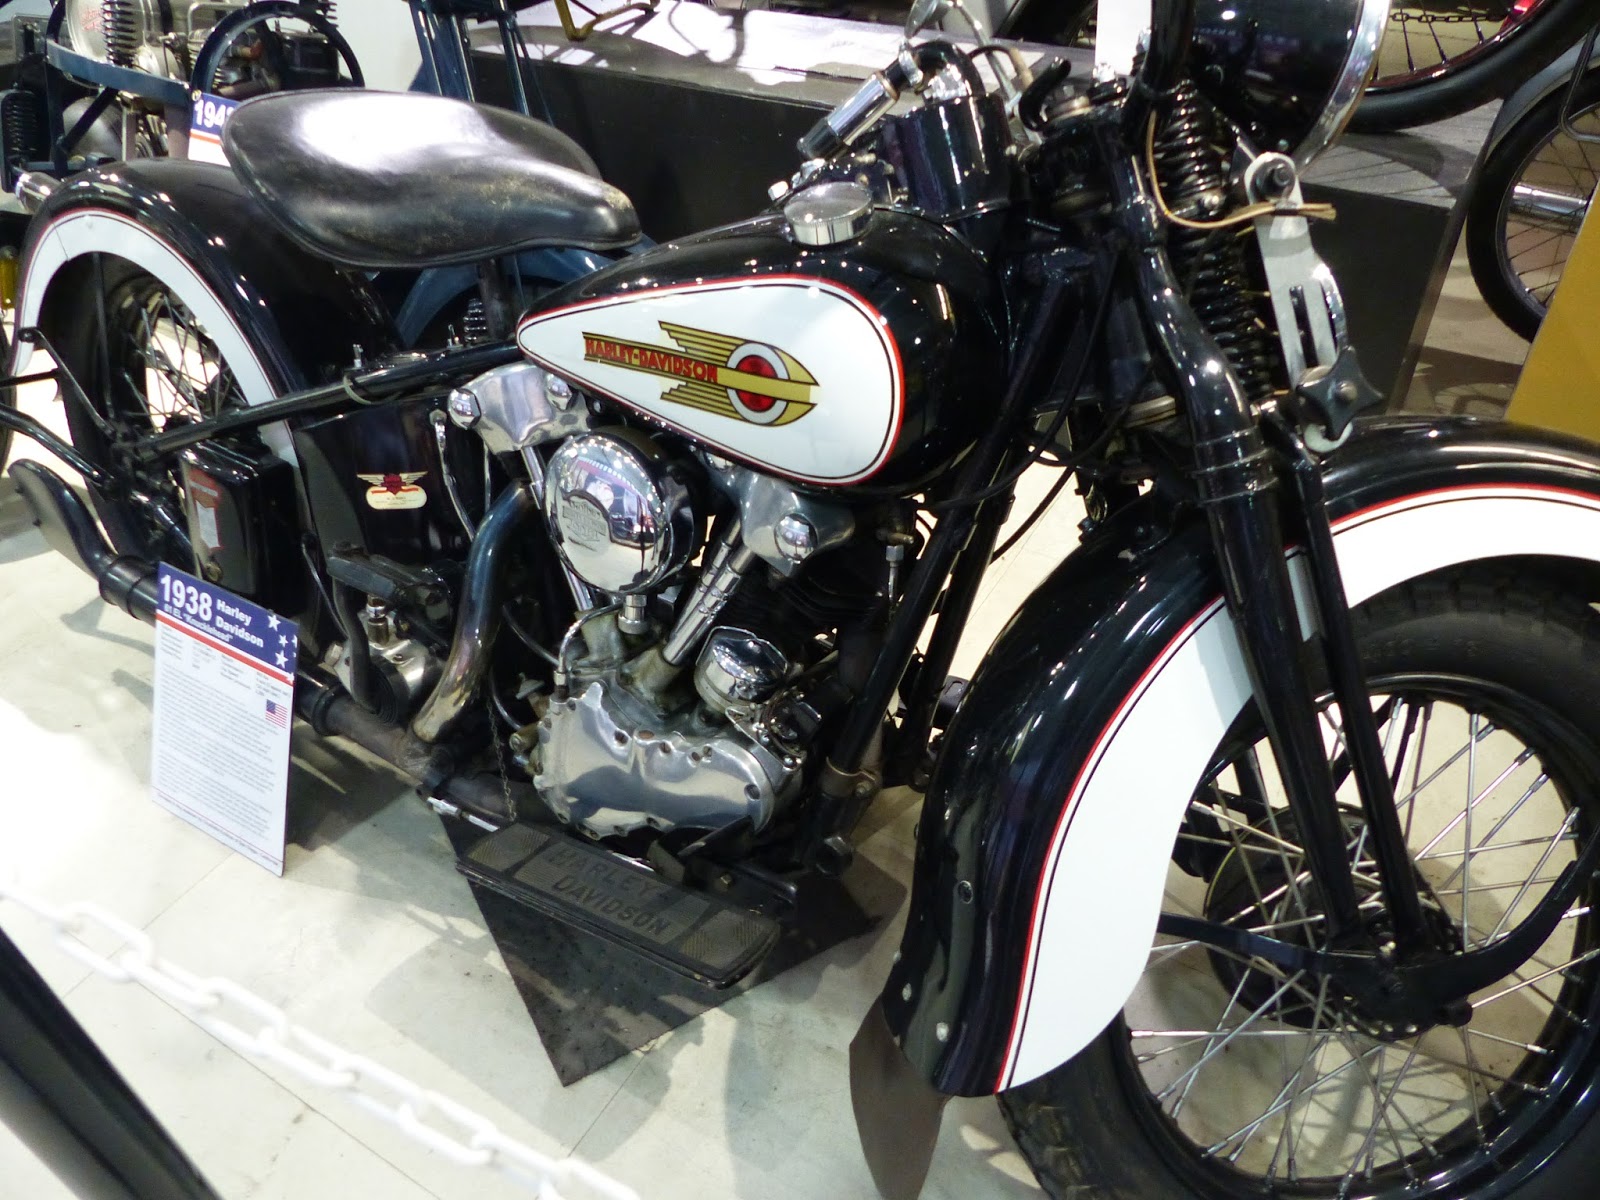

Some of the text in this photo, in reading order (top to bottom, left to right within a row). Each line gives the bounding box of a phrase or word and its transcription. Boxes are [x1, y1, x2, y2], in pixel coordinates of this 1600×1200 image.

[585, 338, 718, 383] HARLEY-DAVIDSON
[160, 574, 213, 622] 1938
[216, 598, 252, 627] Harley
[215, 615, 264, 648] Davidson
[547, 848, 660, 898] HARLEY
[551, 867, 672, 937] DAVIDSON
